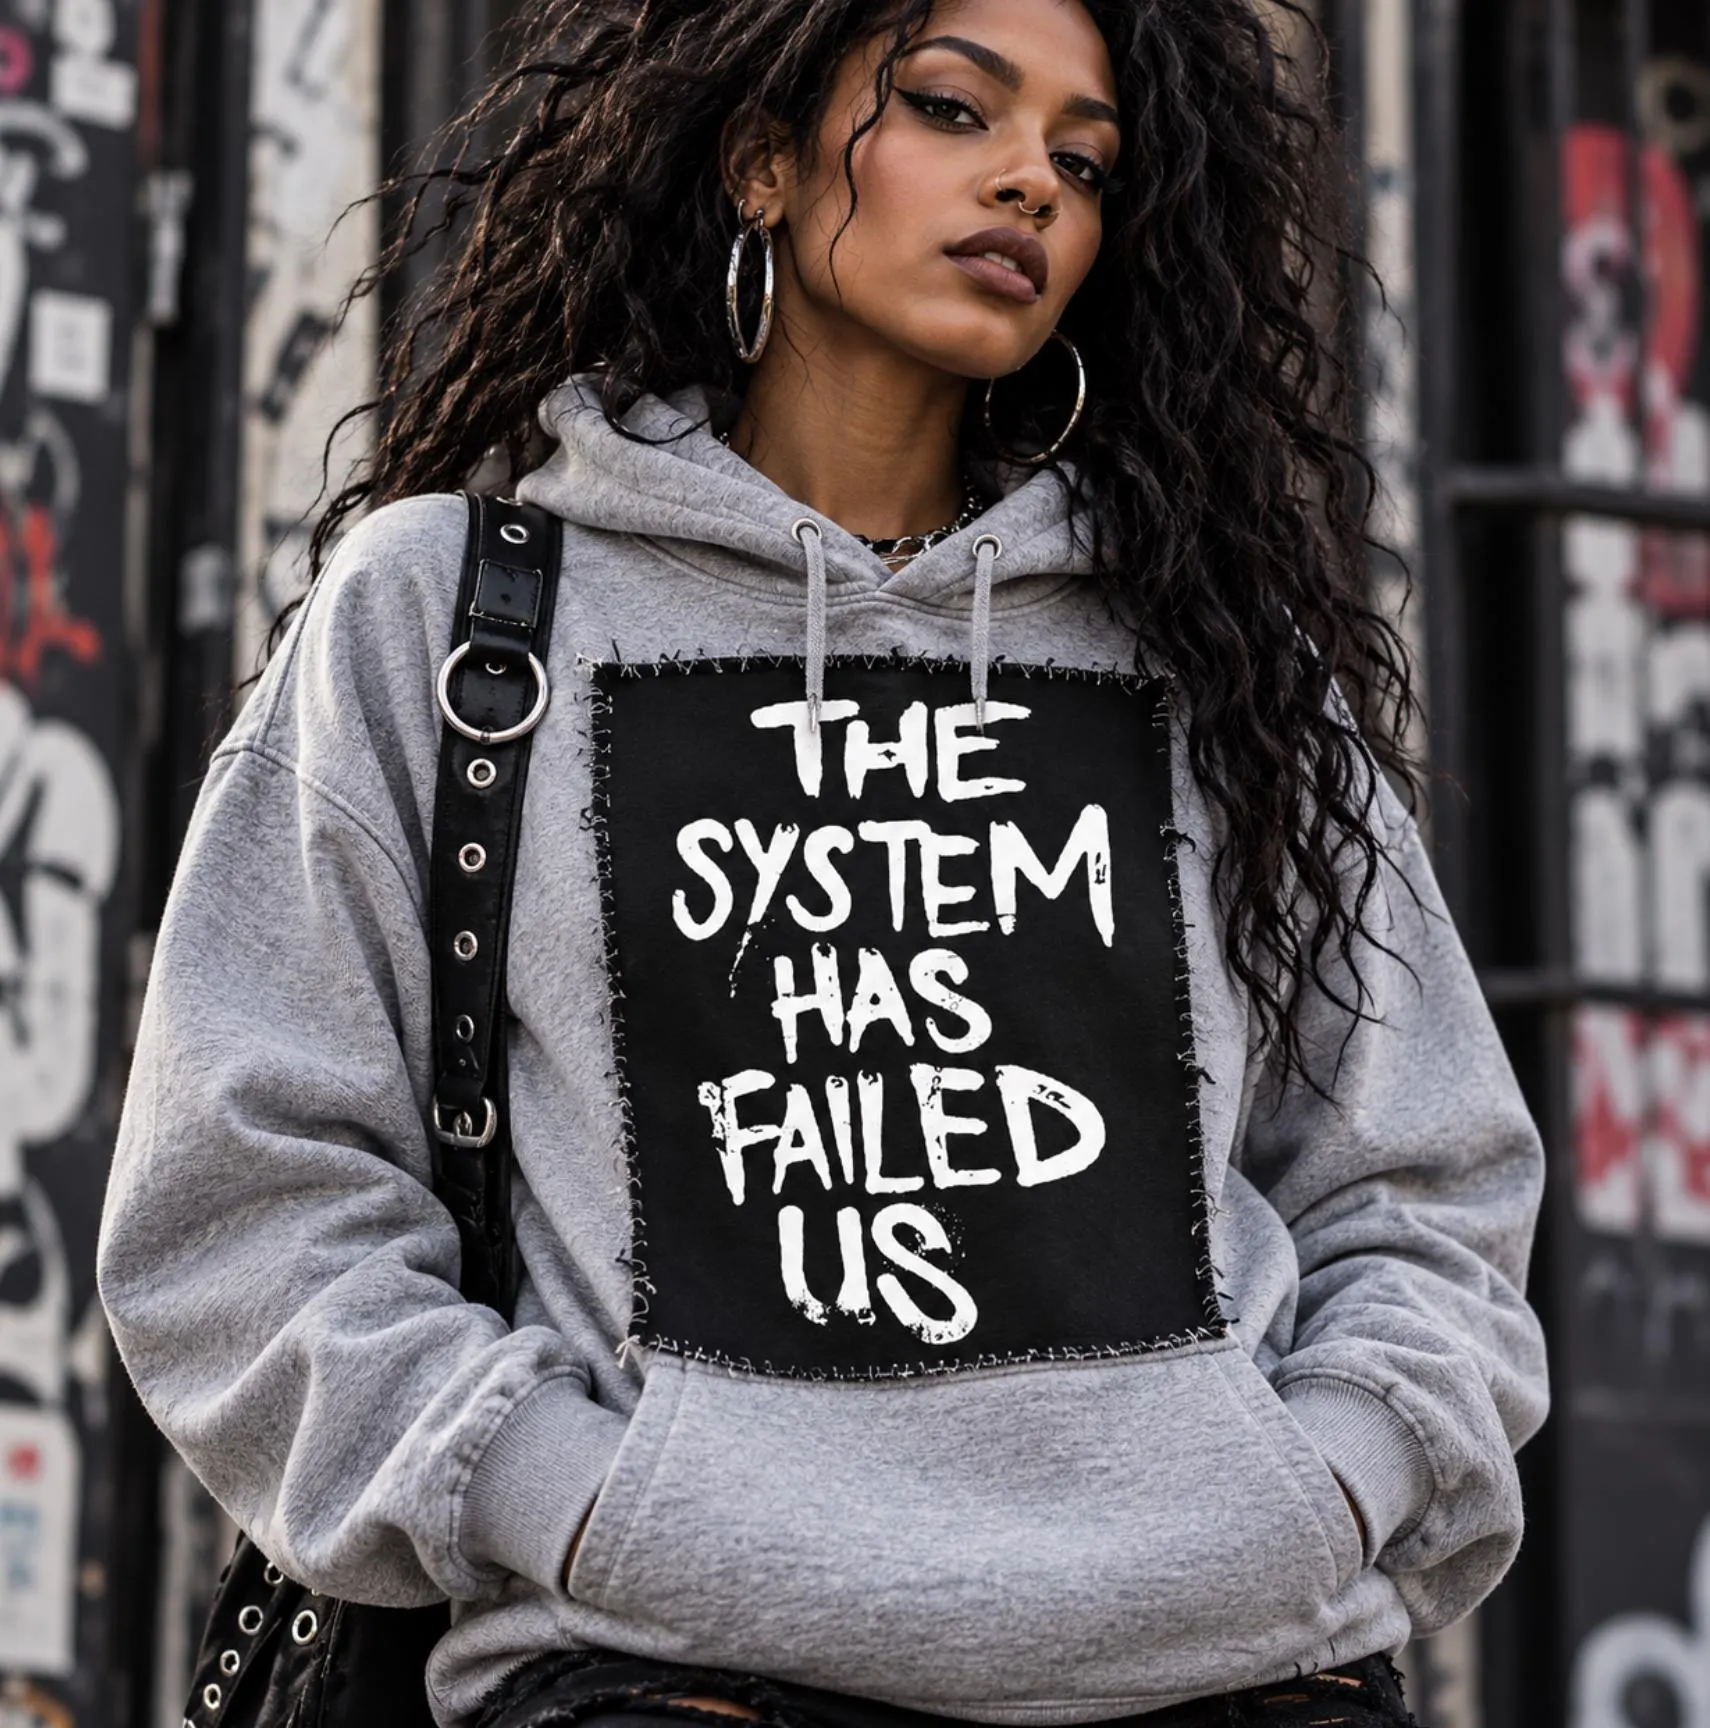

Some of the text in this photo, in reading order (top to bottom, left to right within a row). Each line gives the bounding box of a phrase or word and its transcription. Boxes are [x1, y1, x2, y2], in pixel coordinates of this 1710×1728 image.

[750, 700, 1032, 802] THE
[672, 804, 1114, 950] SYSTEM
[771, 942, 992, 1064] HAS
[698, 1063, 1106, 1206] FAILED
[777, 1203, 978, 1346] US
